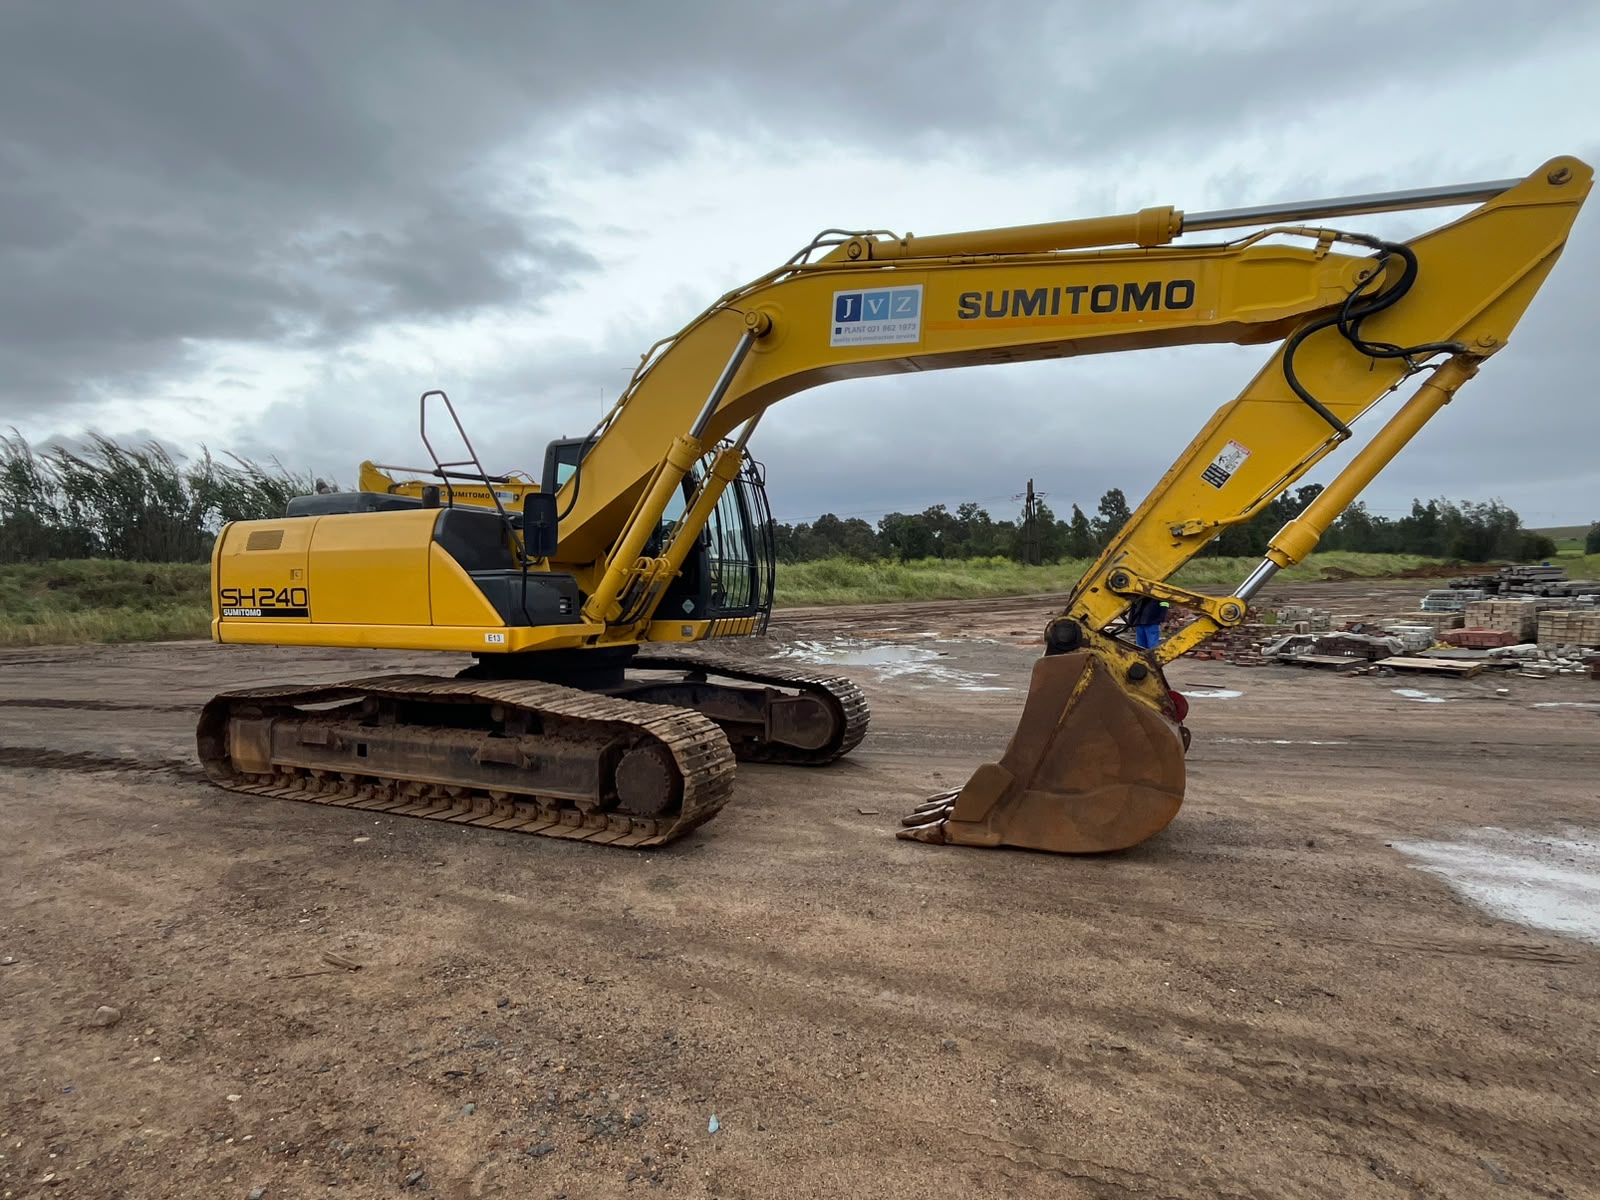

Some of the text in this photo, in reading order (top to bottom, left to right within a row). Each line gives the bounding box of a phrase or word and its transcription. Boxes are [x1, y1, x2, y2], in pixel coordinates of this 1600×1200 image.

[957, 279, 1196, 320] SUMITOMO
[844, 326, 866, 334] PLANT
[867, 325, 880, 333] 021
[447, 491, 490, 499] UMITOMO
[221, 587, 308, 607] SH240
[223, 608, 262, 617] SUMITOMO
[487, 634, 501, 642] E13
